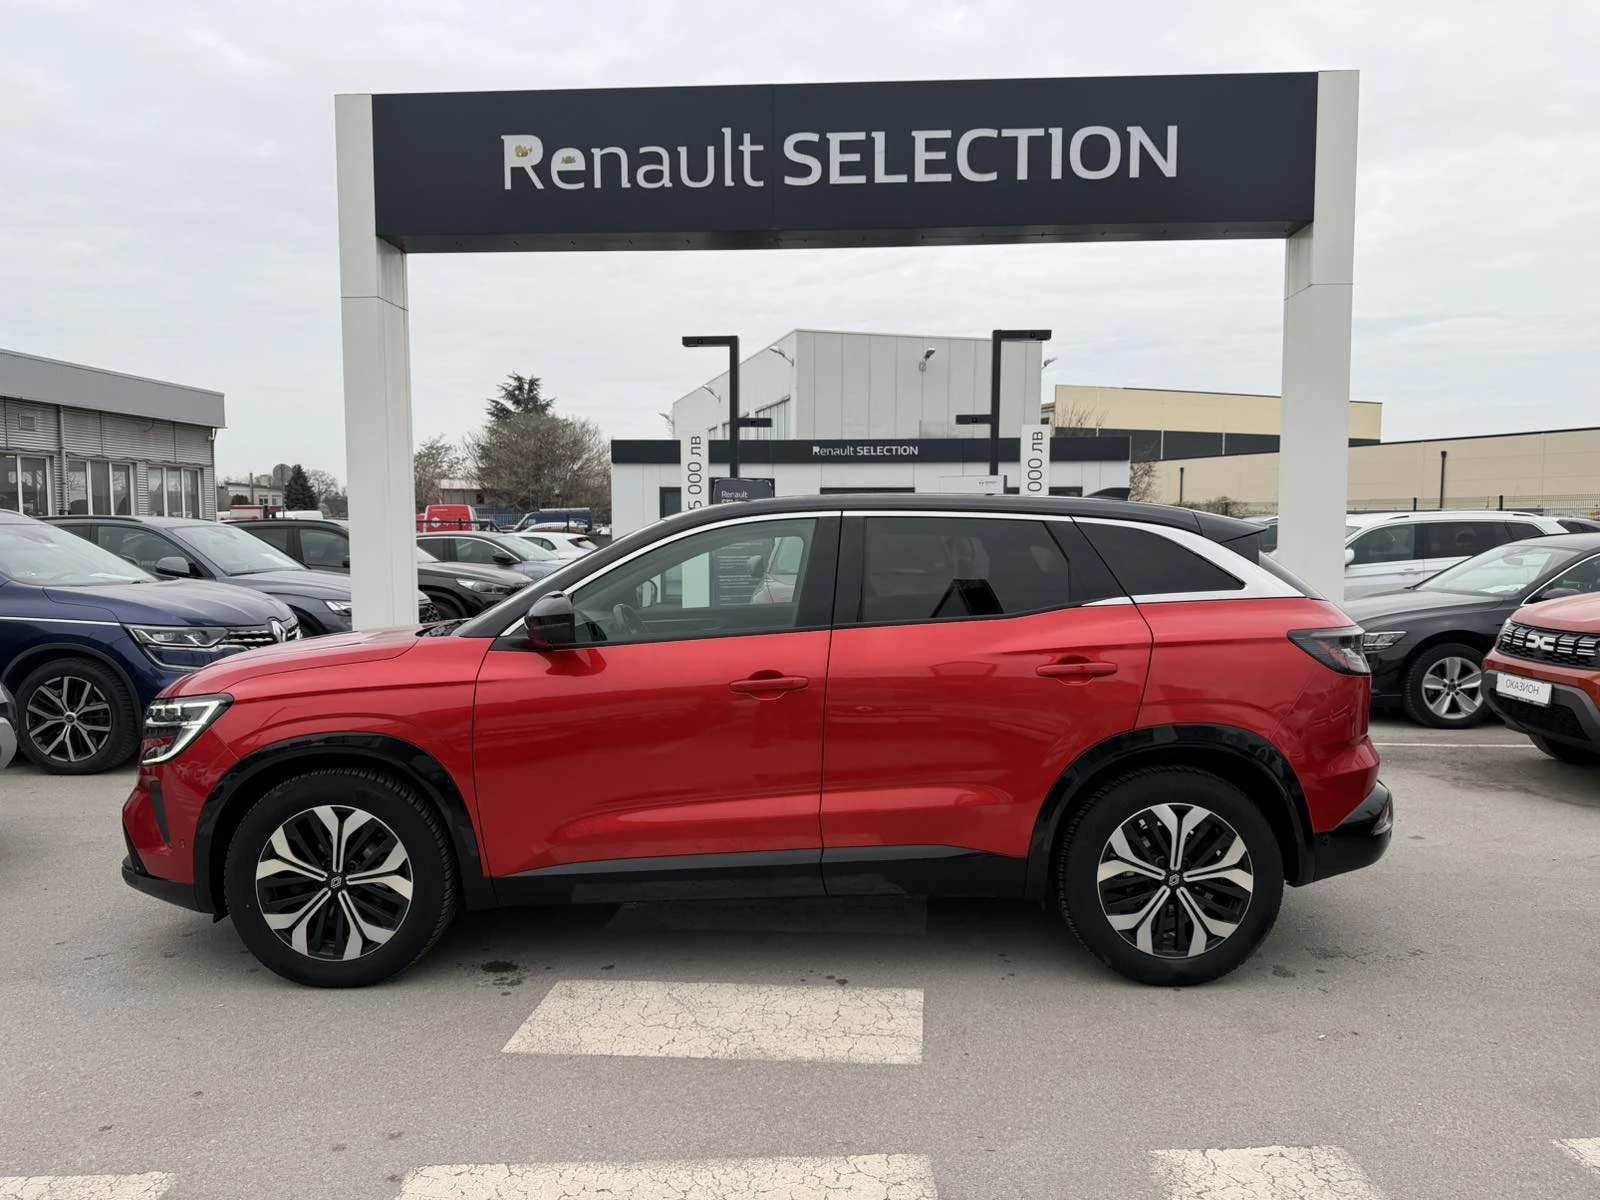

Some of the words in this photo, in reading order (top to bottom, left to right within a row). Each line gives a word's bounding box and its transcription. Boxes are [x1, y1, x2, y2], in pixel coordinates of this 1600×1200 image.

[500, 127, 764, 190] Renault
[783, 124, 1178, 186] SELECTION
[812, 445, 854, 456] Renault
[856, 445, 919, 456] SELECTION
[688, 462, 702, 495] 000
[1027, 458, 1043, 492] 000
[721, 490, 748, 498] Renault
[1505, 679, 1540, 695] ОКАЗИОН
